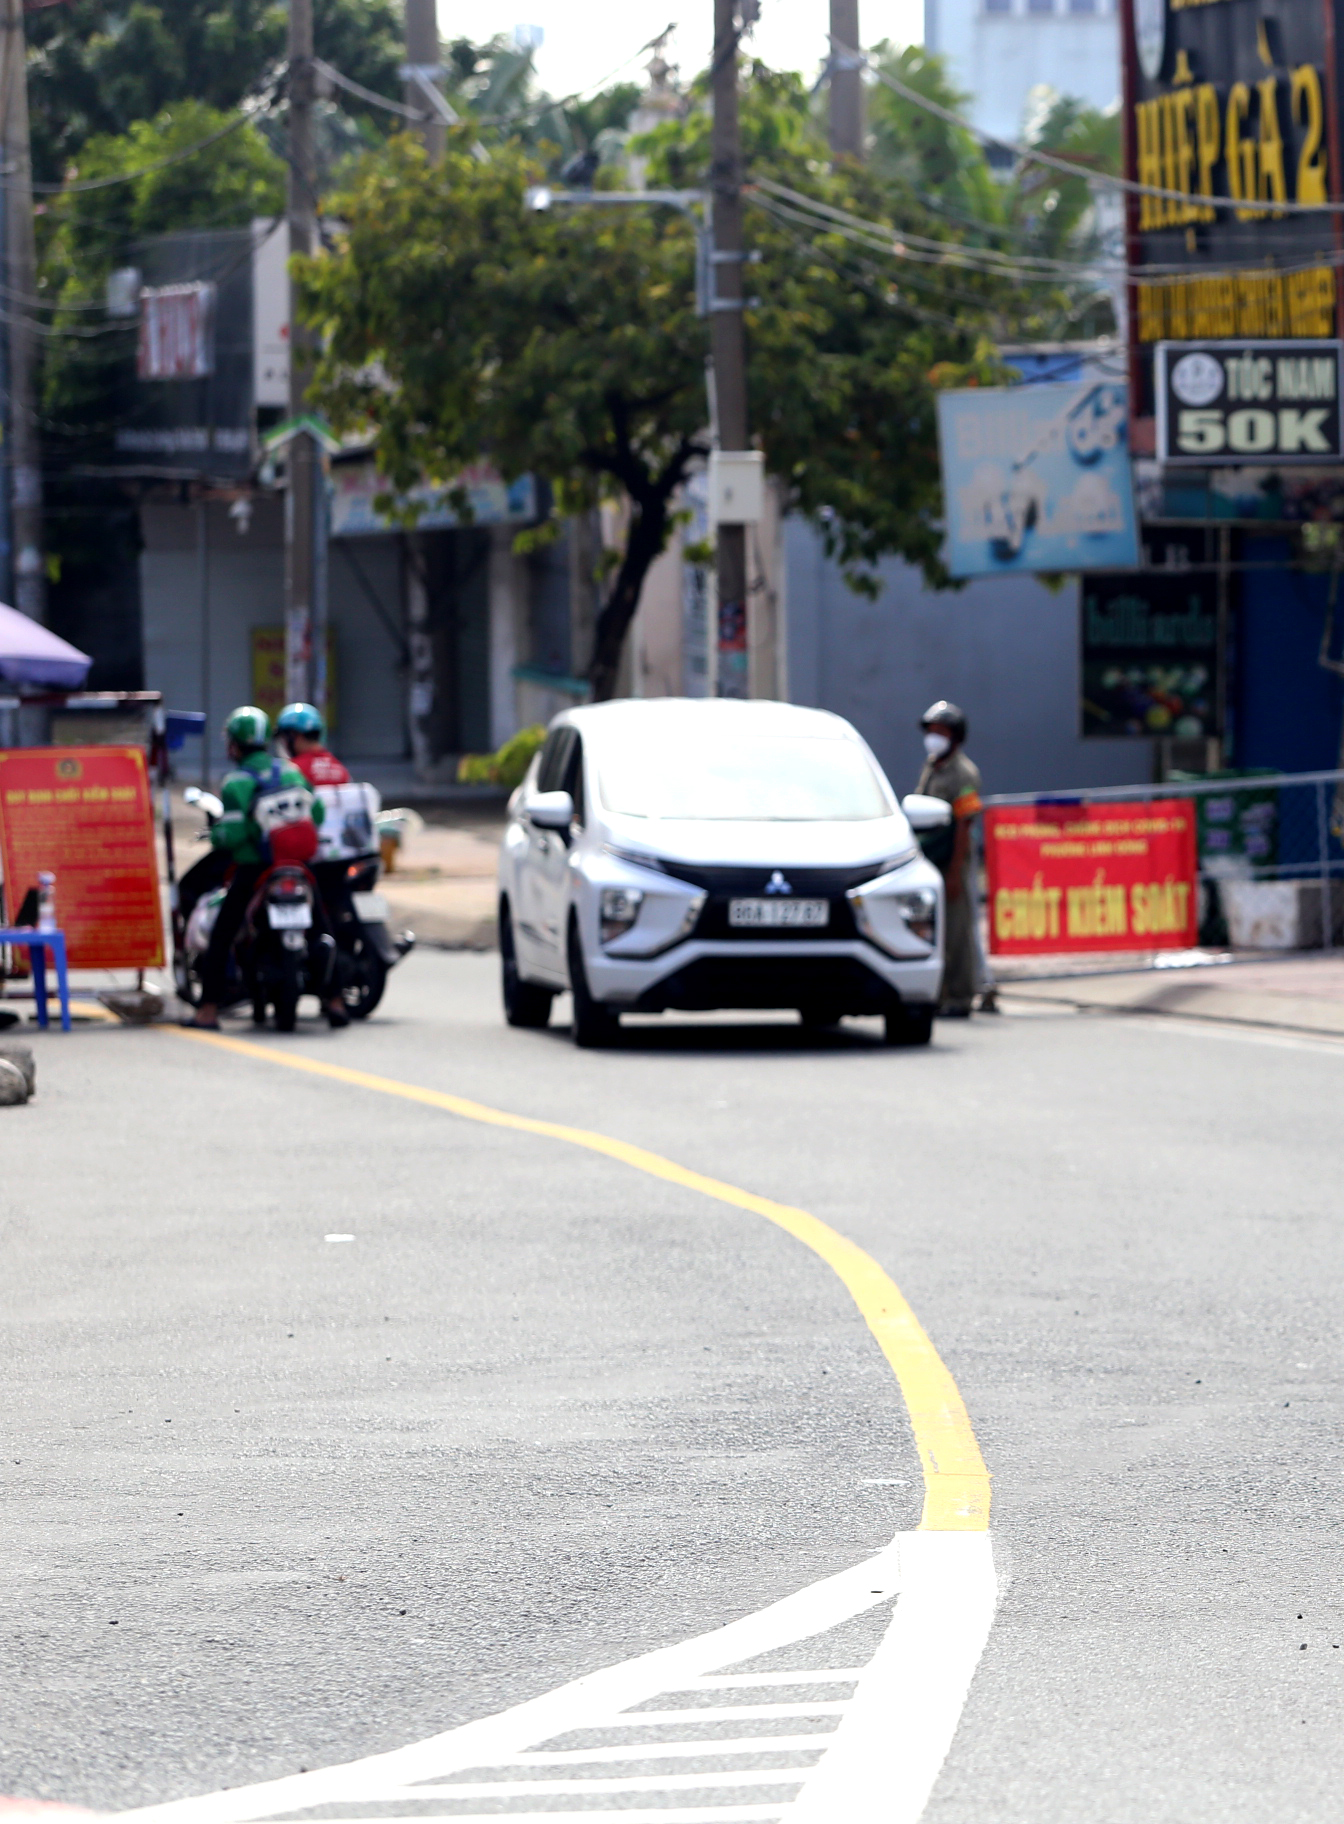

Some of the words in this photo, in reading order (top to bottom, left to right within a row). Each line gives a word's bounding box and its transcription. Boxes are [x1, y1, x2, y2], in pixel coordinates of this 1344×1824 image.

[1289, 63, 1328, 208] 2
[1224, 348, 1274, 401] TÓC
[1275, 356, 1337, 400] NAM
[1177, 408, 1332, 453] 50K
[994, 870, 1062, 941] CHỐT
[1066, 867, 1127, 937] KIỂM
[1130, 873, 1191, 936] SOÁT
